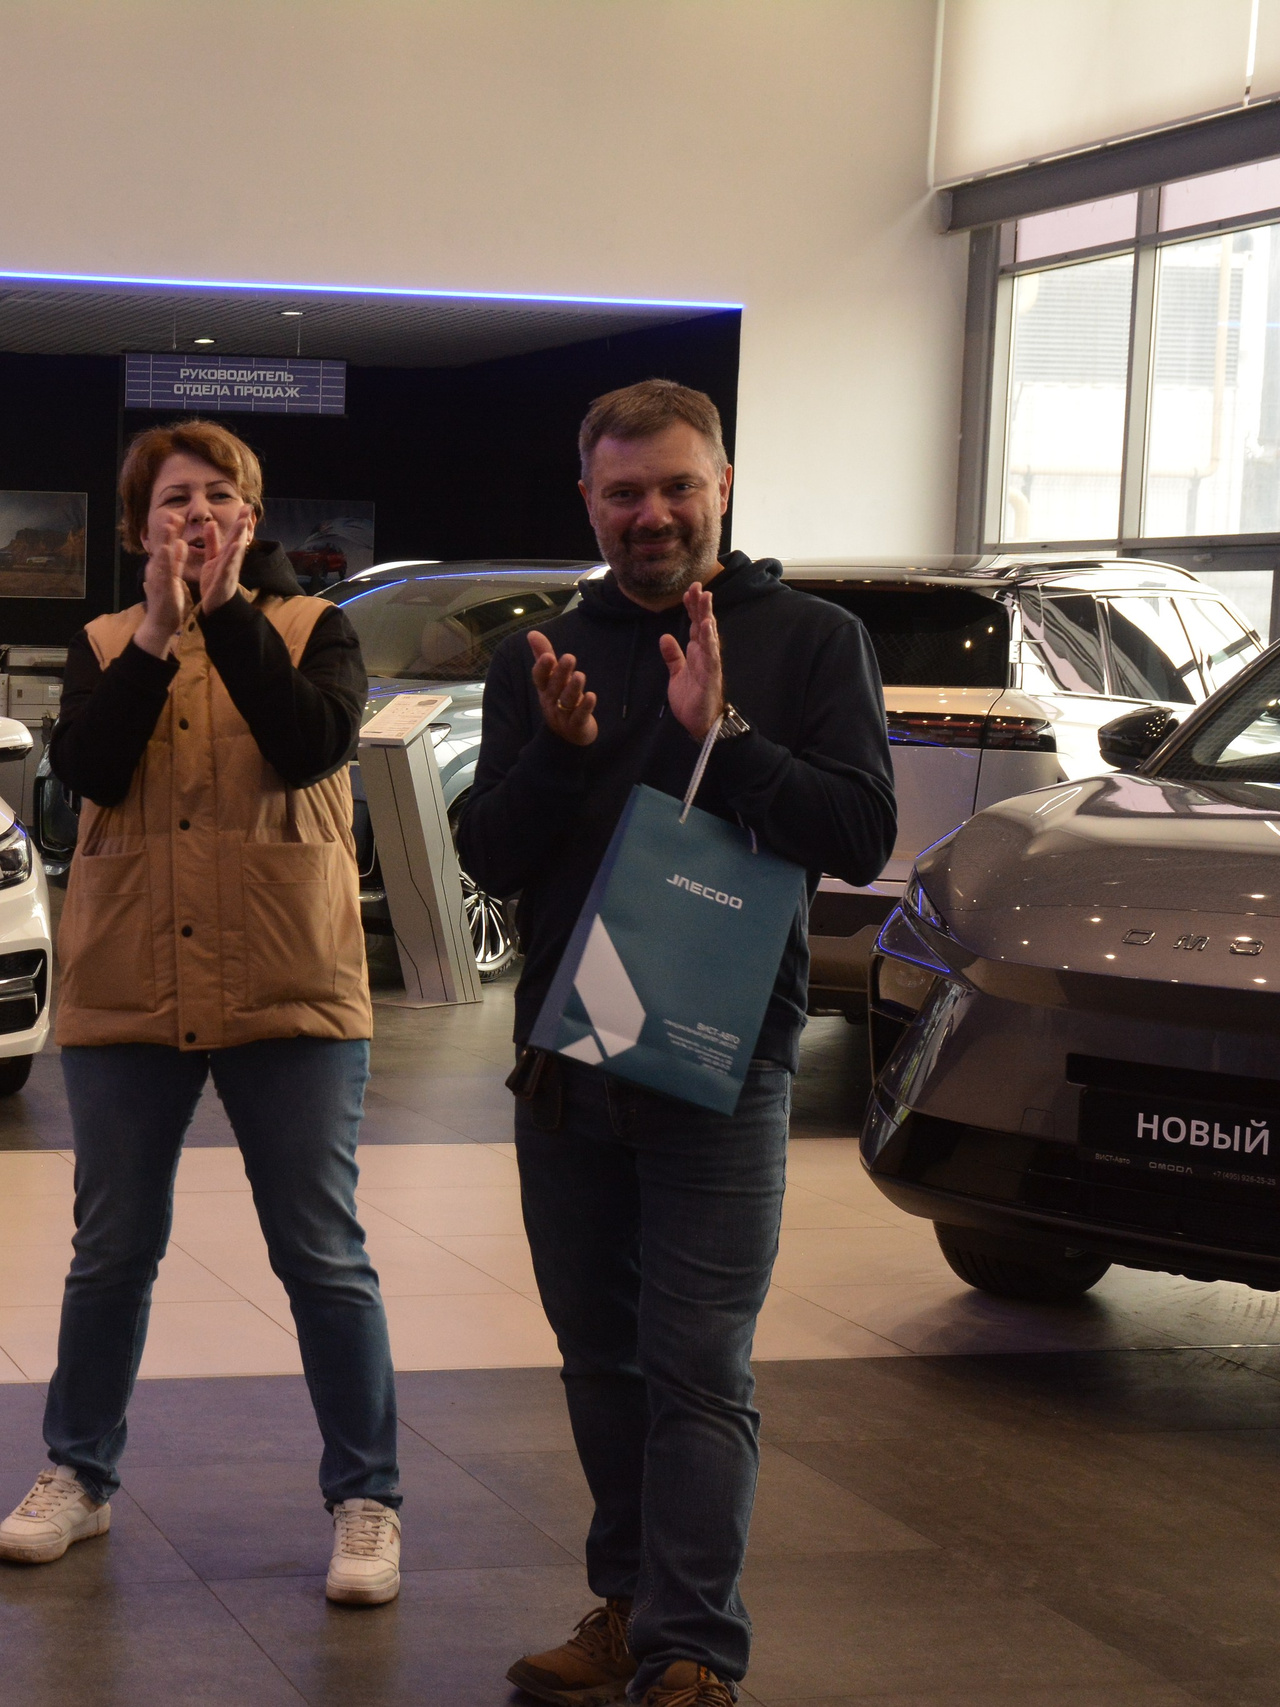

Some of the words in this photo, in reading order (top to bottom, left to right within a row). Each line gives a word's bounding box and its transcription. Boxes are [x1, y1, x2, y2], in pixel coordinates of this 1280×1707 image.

[179, 368, 294, 382] РУКОВОДИТЕЛЬ
[173, 384, 230, 396] ОТДЕЛА
[233, 386, 300, 398] ПРОДАЖ
[666, 873, 743, 910] JAECOO
[1137, 1112, 1270, 1156] НОВЫЙ
[1095, 1152, 1131, 1165] ВИСТ-Авто
[1148, 1161, 1193, 1174] OMODA
[1222, 1171, 1240, 1182] (495)
[1241, 1174, 1276, 1186] 926-25-25
